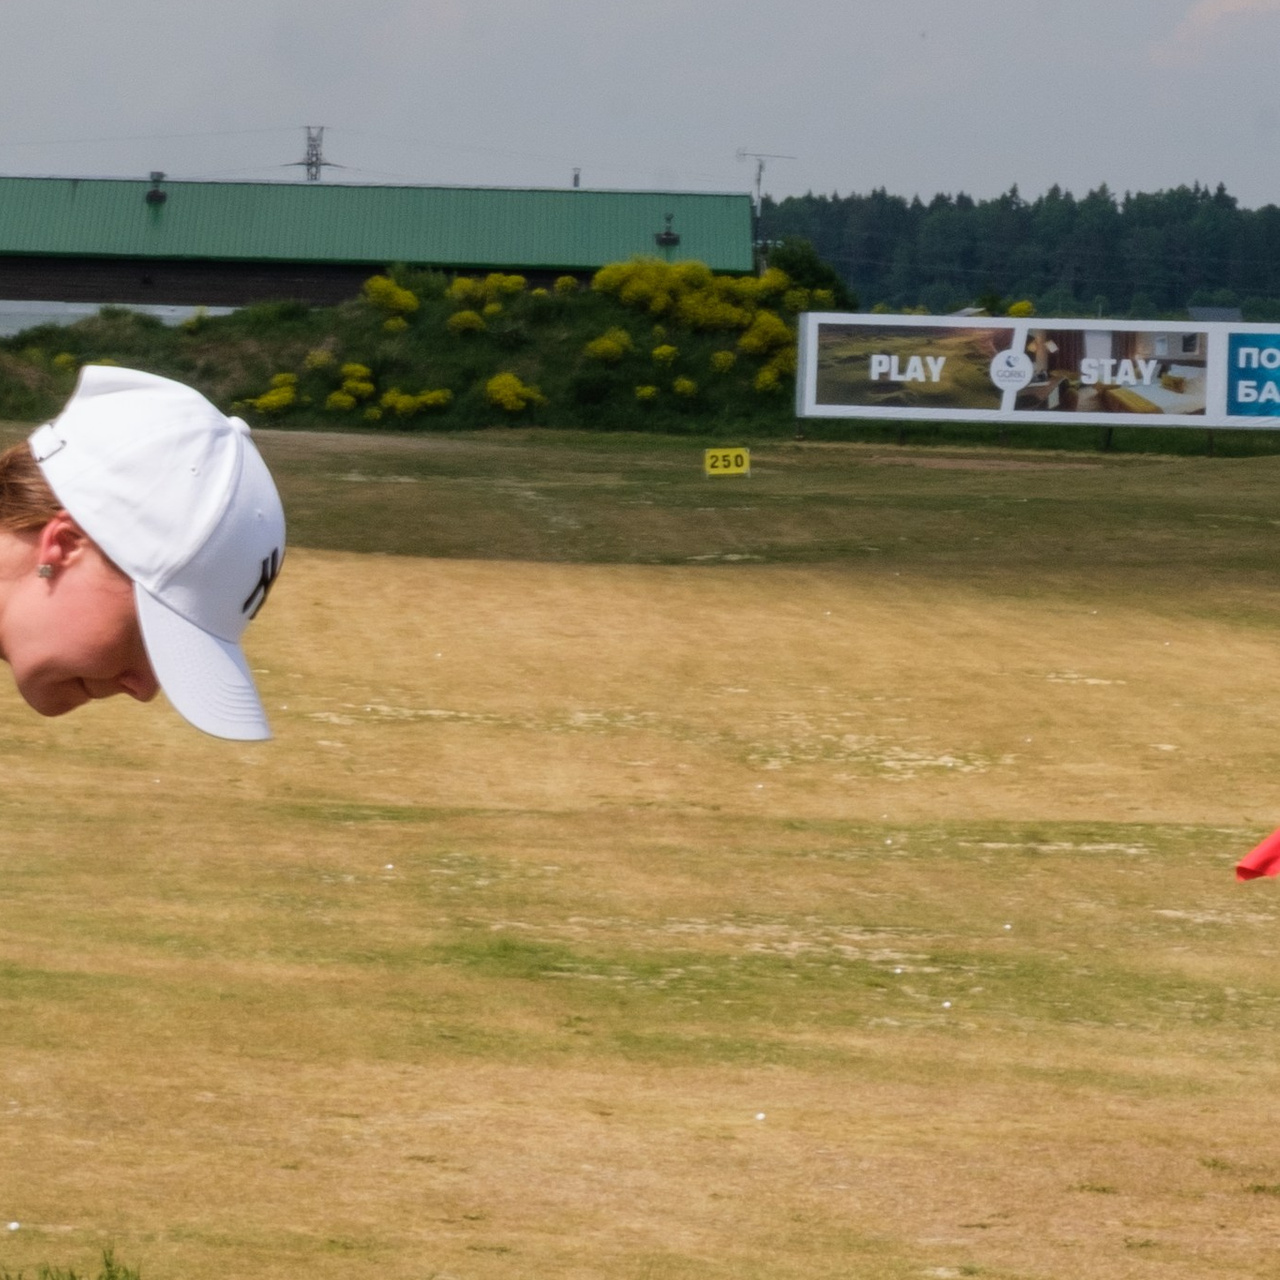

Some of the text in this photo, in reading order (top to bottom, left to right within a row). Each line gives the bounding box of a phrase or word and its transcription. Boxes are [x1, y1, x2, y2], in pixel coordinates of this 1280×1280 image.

[871, 354, 947, 382] PLAY
[1080, 358, 1158, 386] STAY
[710, 454, 744, 469] 250
